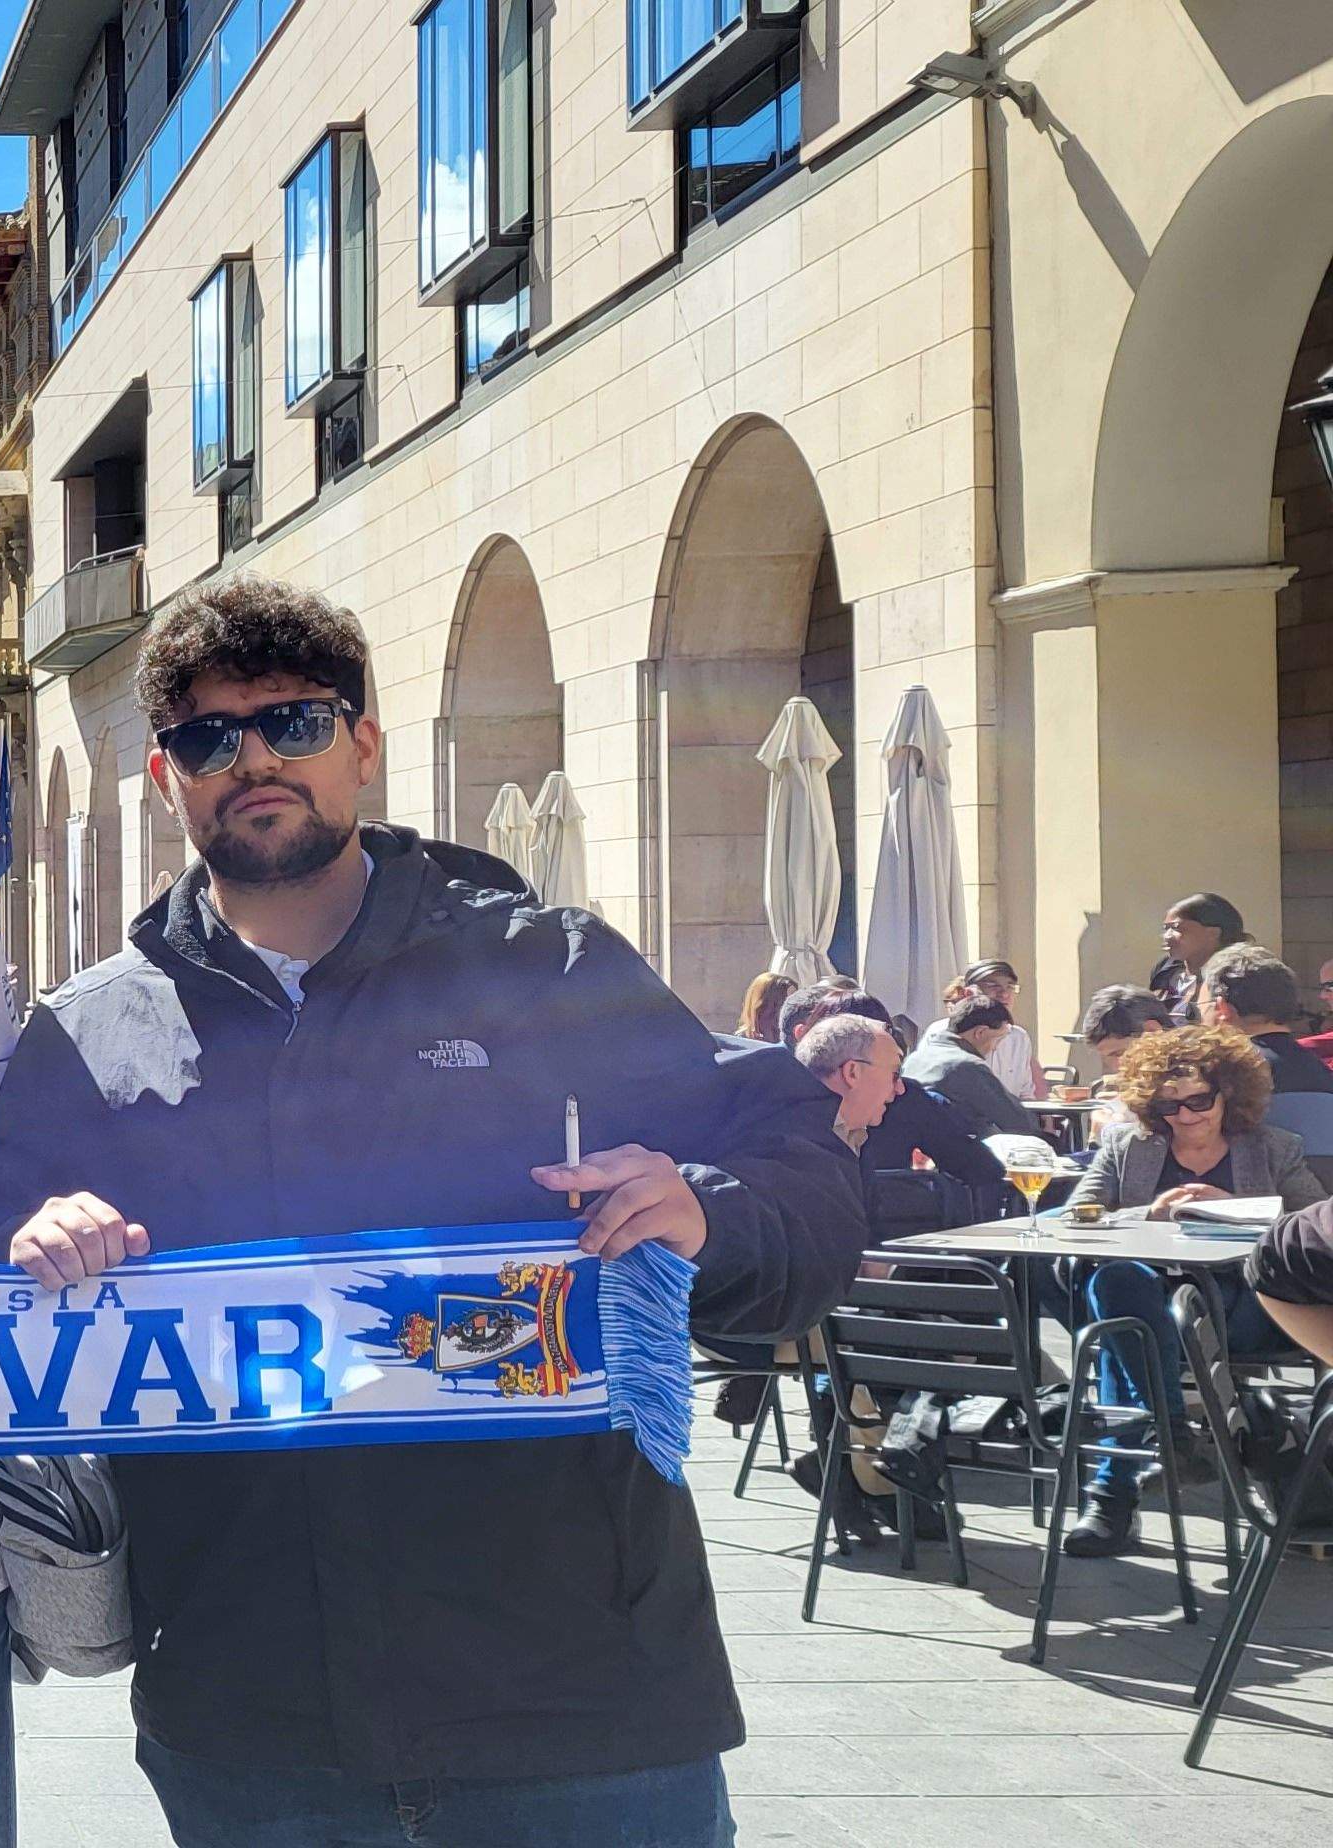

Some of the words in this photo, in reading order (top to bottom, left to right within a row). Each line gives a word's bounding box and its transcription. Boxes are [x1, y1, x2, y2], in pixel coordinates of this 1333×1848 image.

[435, 1040, 463, 1050] THE
[418, 1049, 465, 1060] NORTH
[433, 1058, 467, 1069] FACE
